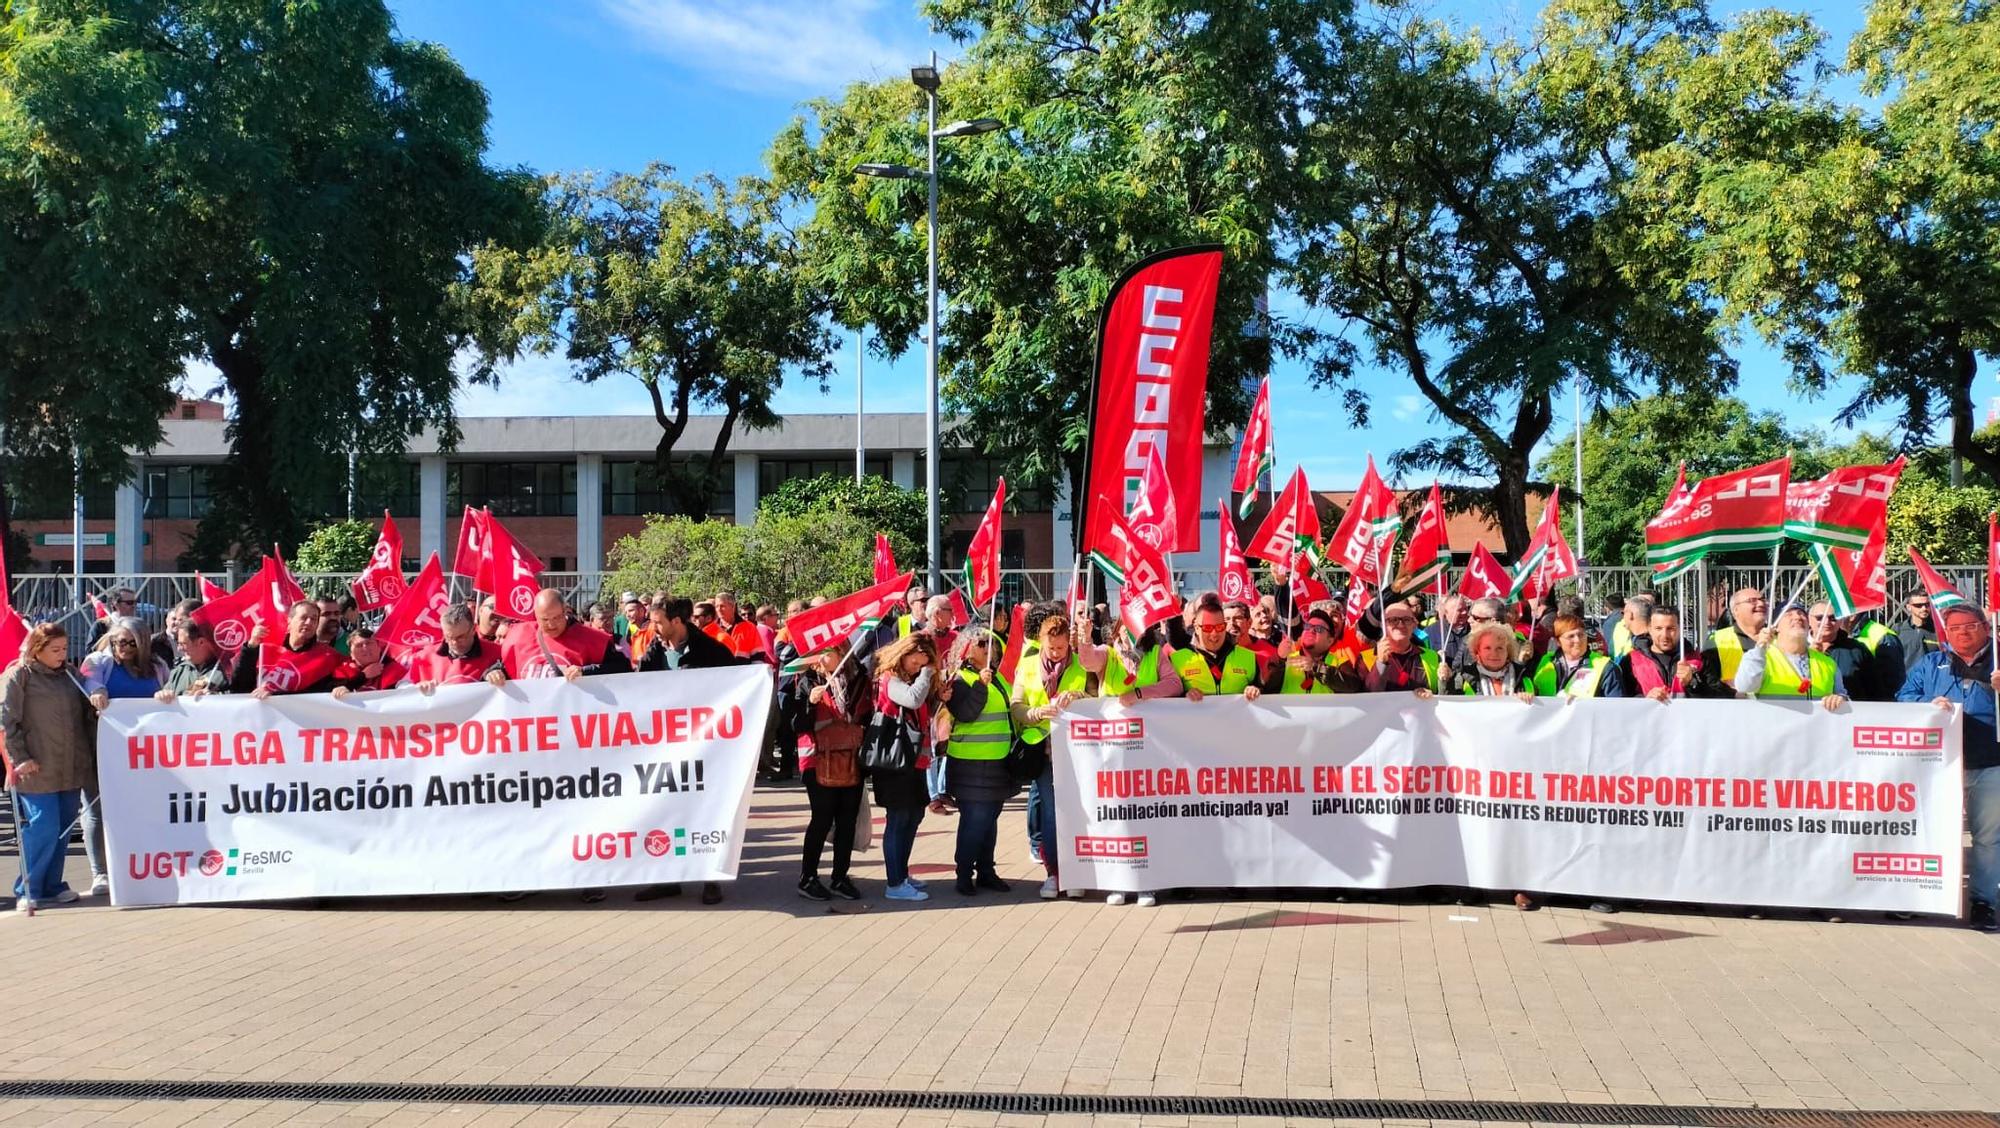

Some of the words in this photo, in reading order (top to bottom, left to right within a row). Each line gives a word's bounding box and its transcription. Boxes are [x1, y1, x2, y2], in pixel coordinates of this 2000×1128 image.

[1125, 285, 1184, 471] CCOO
[128, 730, 286, 769] HUELGA
[298, 715, 560, 763] TRANSPORTE
[570, 704, 744, 749] VIAJERO
[1073, 722, 1127, 737] CCOO
[1857, 730, 1925, 746] CCOO
[222, 777, 413, 815] Jubilación
[424, 767, 622, 808] Anticipada
[634, 759, 705, 795] YA!!
[1096, 767, 1192, 798] HUELGA
[1196, 766, 1305, 795] GENERAL
[1313, 765, 1344, 794] EN
[1351, 765, 1377, 794] EL
[1383, 765, 1482, 796] SECTOR
[1489, 770, 1537, 801] DEL
[1543, 772, 1726, 808] TRANSPORTE
[1733, 778, 1767, 809] DE
[1774, 779, 1916, 813] VIAJEROS
[1096, 801, 1178, 822] ¡Jubilación
[1181, 799, 1263, 819] anticipada
[1265, 799, 1289, 818] ya!
[1414, 797, 1431, 815] DE
[1434, 797, 1540, 821] COEFICIENTES
[1544, 805, 1649, 827] REDUCTORES
[1653, 810, 1684, 828] YA!!
[1707, 814, 1793, 833] ¡Paremos
[1798, 816, 1826, 834] las
[1831, 817, 1917, 836] muertes!
[243, 850, 293, 866] FeSMC
[572, 831, 638, 862] UGT
[1079, 840, 1132, 853] CCOO
[129, 851, 193, 880] UGT
[1857, 857, 1922, 872] CCOO
